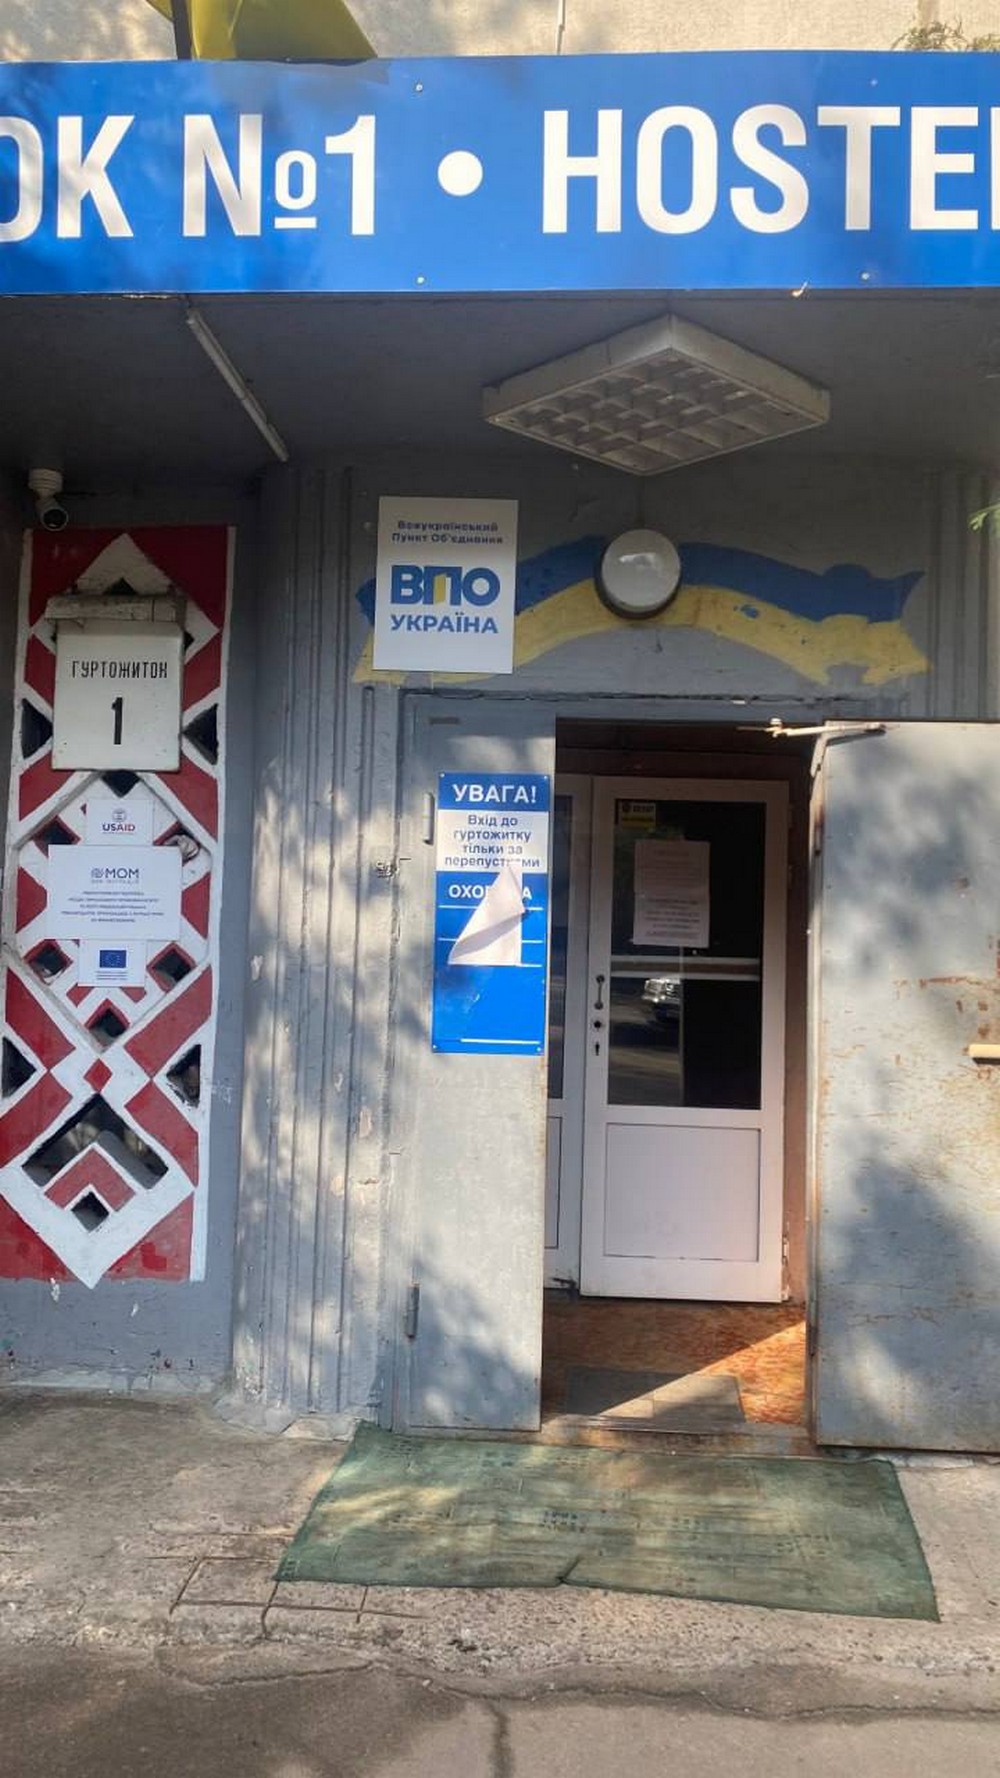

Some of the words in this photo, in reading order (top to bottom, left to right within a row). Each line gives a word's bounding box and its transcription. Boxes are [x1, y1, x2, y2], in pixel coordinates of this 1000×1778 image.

[183, 114, 377, 238] №1
[542, 104, 1000, 235] HOSTE
[392, 532, 427, 543] Пункт
[390, 564, 501, 607] ВПО
[391, 611, 499, 634] УКРАЇНА
[72, 660, 168, 679] ГУРТОЖИТОК
[111, 697, 123, 745] 1
[452, 784, 537, 804] УВАГА!
[102, 822, 136, 832] USAID
[467, 814, 498, 828] Вхід
[501, 816, 518, 828] до
[453, 830, 532, 843] гуртожитку
[463, 844, 504, 855] тільки
[508, 846, 524, 856] за
[445, 856, 540, 869] перепустми
[104, 867, 139, 879] МОМ
[448, 884, 532, 900] ОХОА
